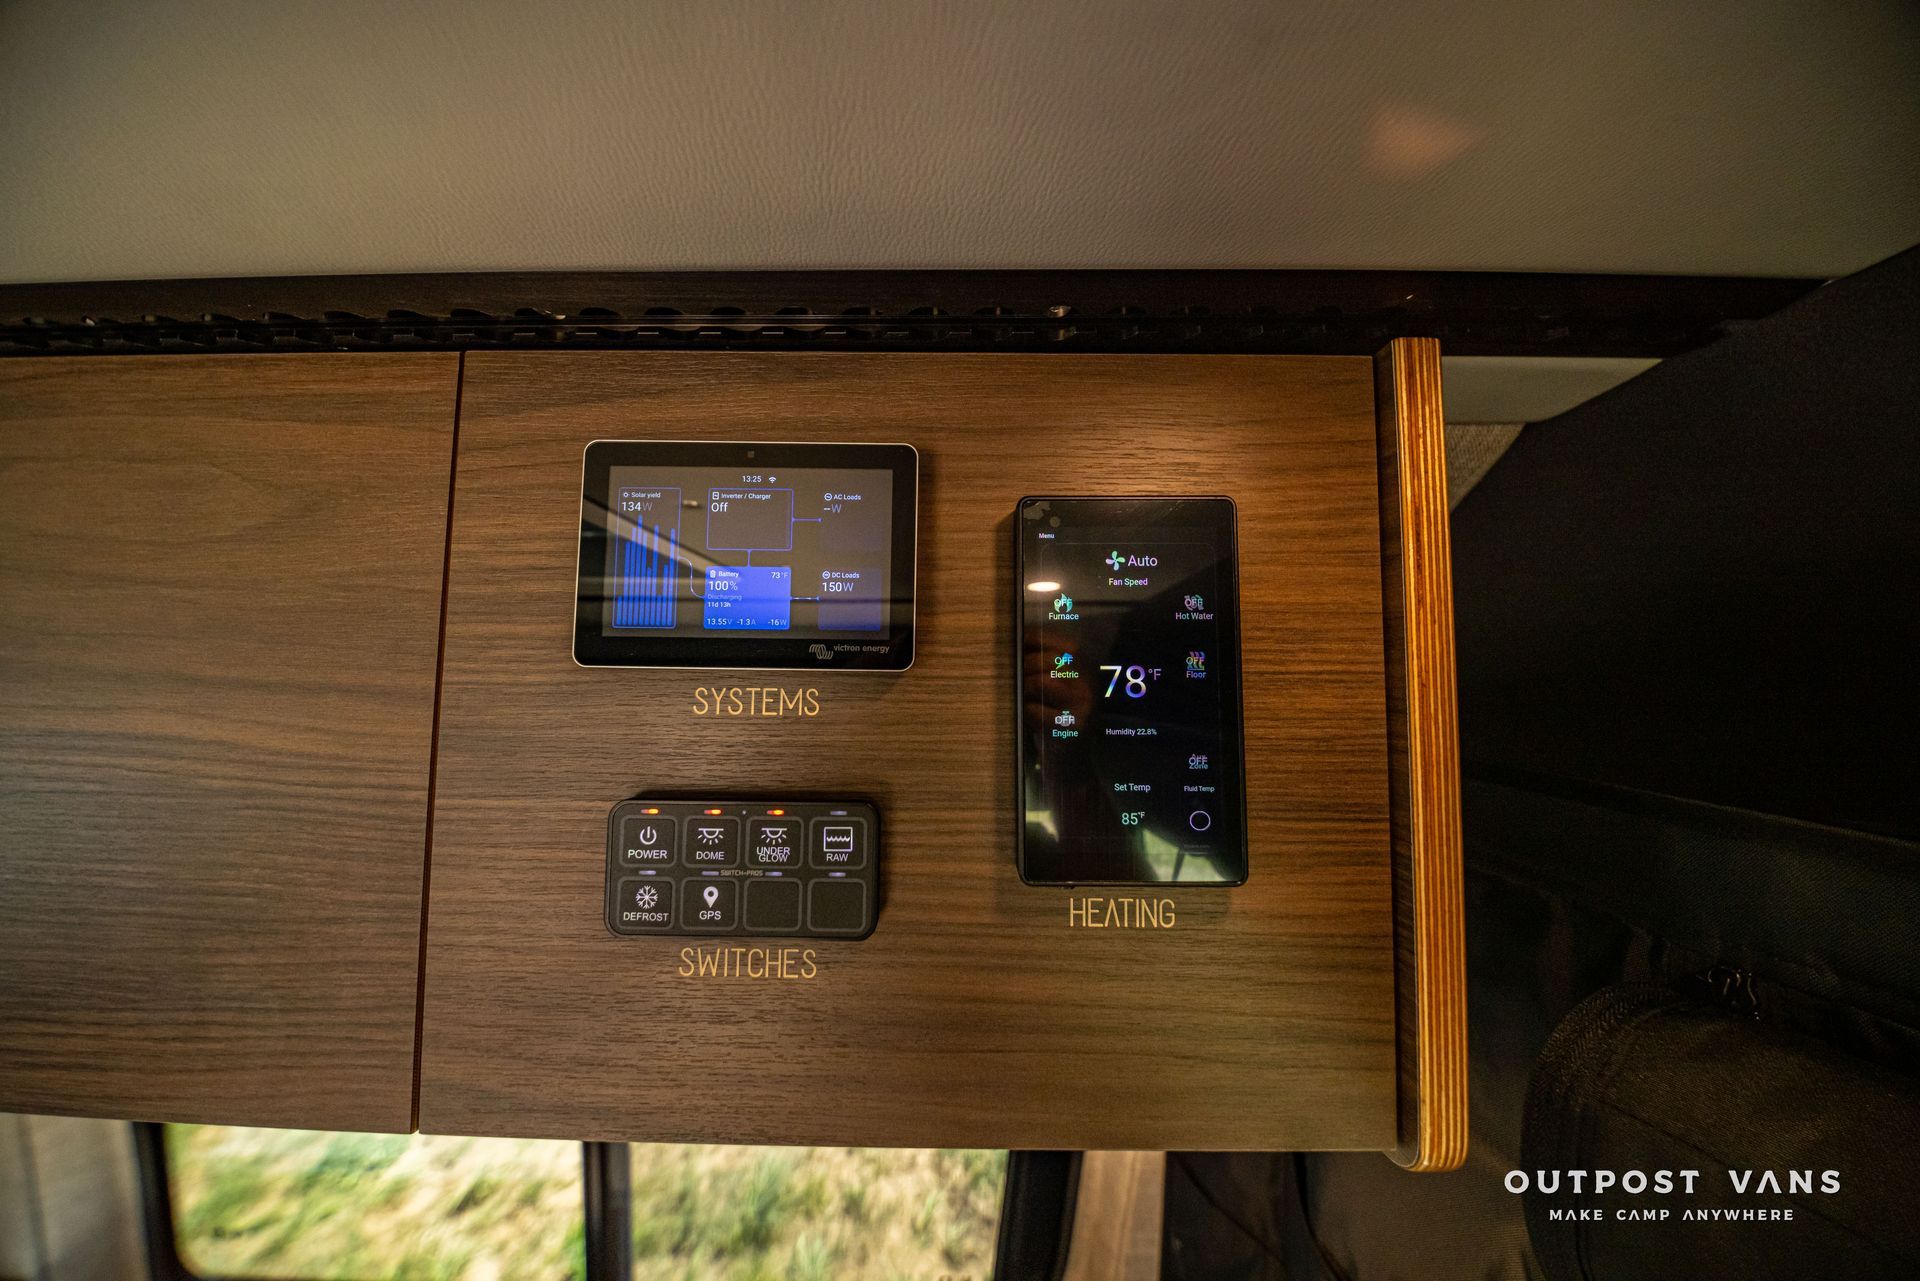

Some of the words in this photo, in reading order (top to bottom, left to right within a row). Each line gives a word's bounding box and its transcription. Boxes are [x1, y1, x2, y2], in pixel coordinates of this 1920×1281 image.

[711, 502, 728, 512] Off
[1128, 555, 1158, 567] Auto
[1108, 578, 1123, 586] Fan
[1124, 578, 1148, 587] Speed
[1048, 612, 1079, 620] Furnace
[1176, 612, 1188, 620] Hot
[1189, 612, 1214, 620] Water
[834, 644, 860, 652] victron
[862, 645, 890, 653] energy
[1054, 657, 1073, 665] OFF
[1186, 670, 1206, 678] Floor
[692, 687, 820, 716] SYSTEMS
[1052, 730, 1078, 739] Engine
[1106, 728, 1136, 737] Humidity
[1137, 728, 1157, 736] 22.8%
[1189, 757, 1208, 765] OFF
[1114, 784, 1128, 792] Set
[1129, 784, 1151, 793] Temp
[628, 850, 668, 859] POWER
[696, 851, 725, 861] DOME
[756, 847, 790, 856] UNDER
[758, 854, 789, 863] GLOW
[826, 853, 848, 862] RAW
[623, 912, 669, 922] DEFROST
[699, 910, 722, 921] GPS
[1069, 897, 1176, 928] HEATING
[678, 947, 817, 979] SWITCHES
